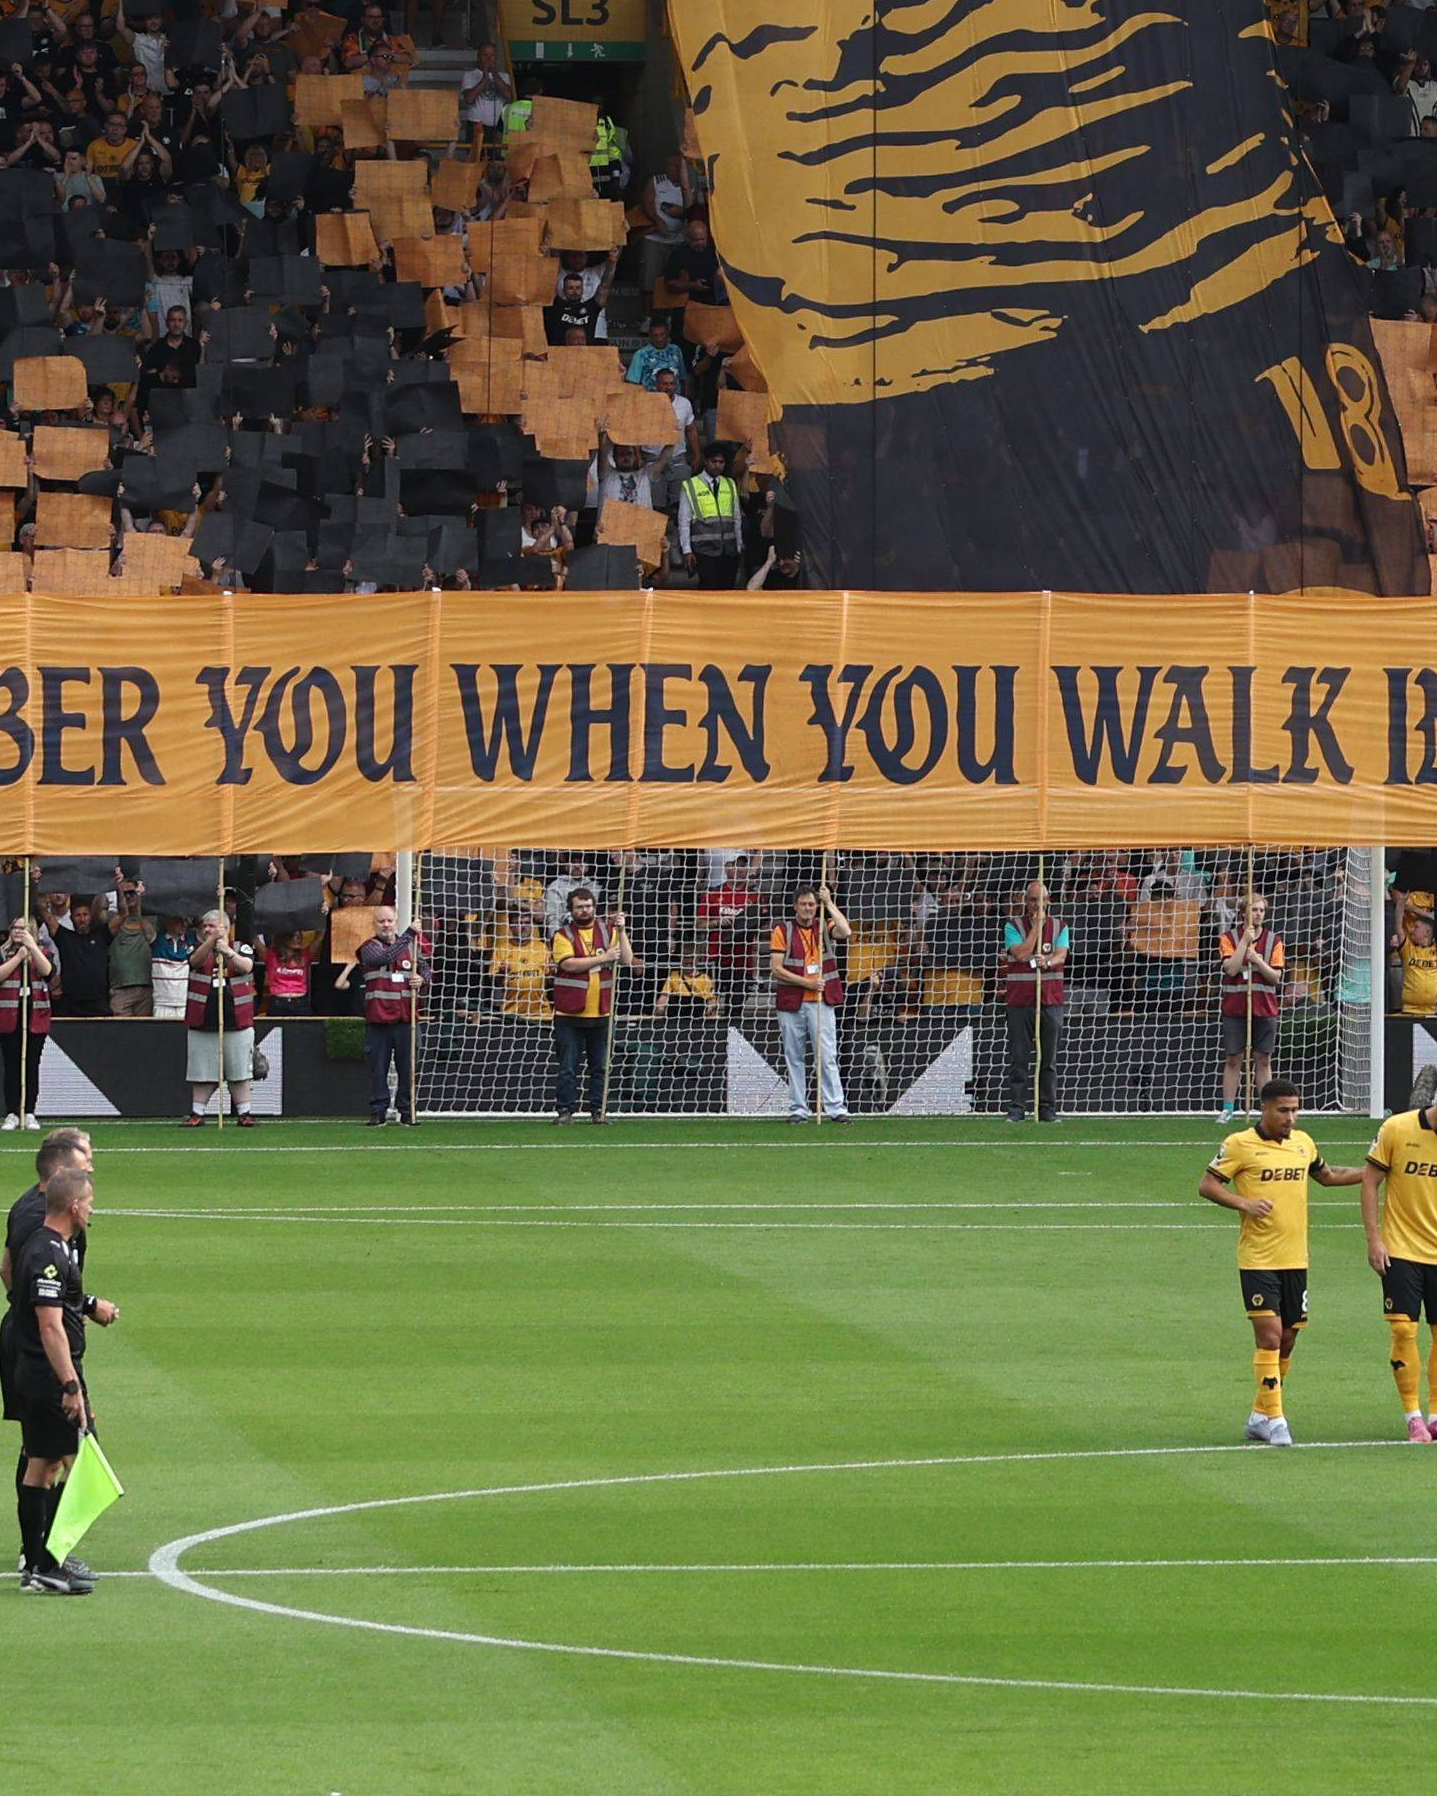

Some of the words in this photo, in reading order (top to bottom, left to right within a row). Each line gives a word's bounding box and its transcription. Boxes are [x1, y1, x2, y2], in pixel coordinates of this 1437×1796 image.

[1254, 342, 1413, 502] 18
[195, 665, 419, 786] YOU
[450, 664, 773, 783] WHEN
[798, 665, 1020, 786] YOU
[1051, 666, 1355, 786] WALK
[1260, 1167, 1307, 1182] DEBET
